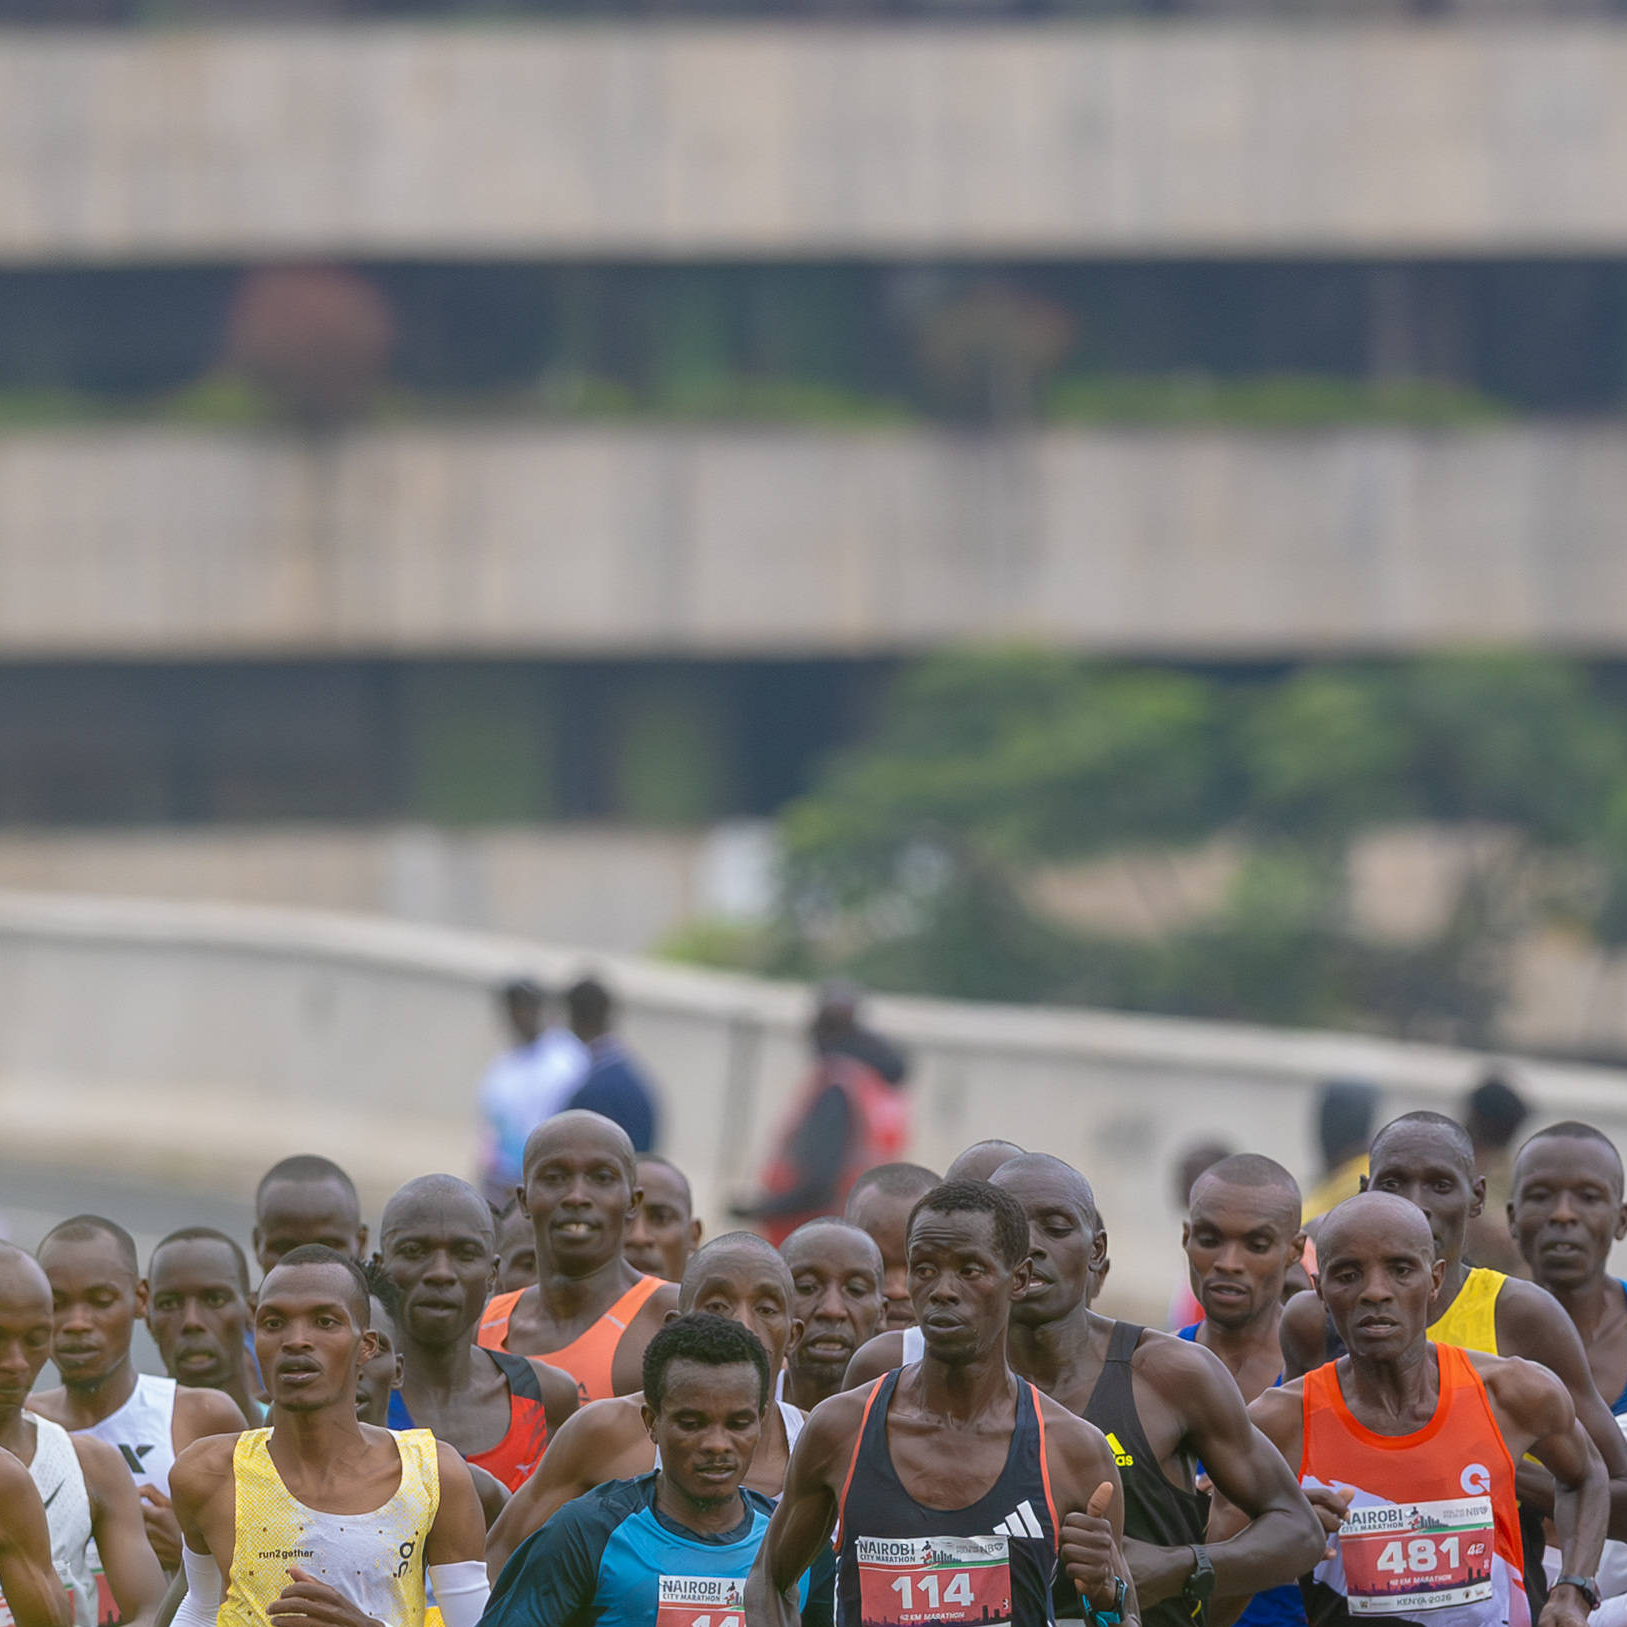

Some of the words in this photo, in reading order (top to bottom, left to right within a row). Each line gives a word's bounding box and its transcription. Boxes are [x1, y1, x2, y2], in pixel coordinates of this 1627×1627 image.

[1360, 1522, 1404, 1530] MARATHON
[859, 1541, 915, 1555] NAIROBI
[1467, 1543, 1485, 1556] 42
[258, 1549, 314, 1560] run2gether
[875, 1555, 916, 1563] MARATHON
[1377, 1536, 1460, 1574] 481
[662, 1580, 722, 1595] NAIROBI
[891, 1572, 975, 1609] 114
[681, 1594, 721, 1602] MARATHON
[924, 1612, 965, 1620] MARATHON
